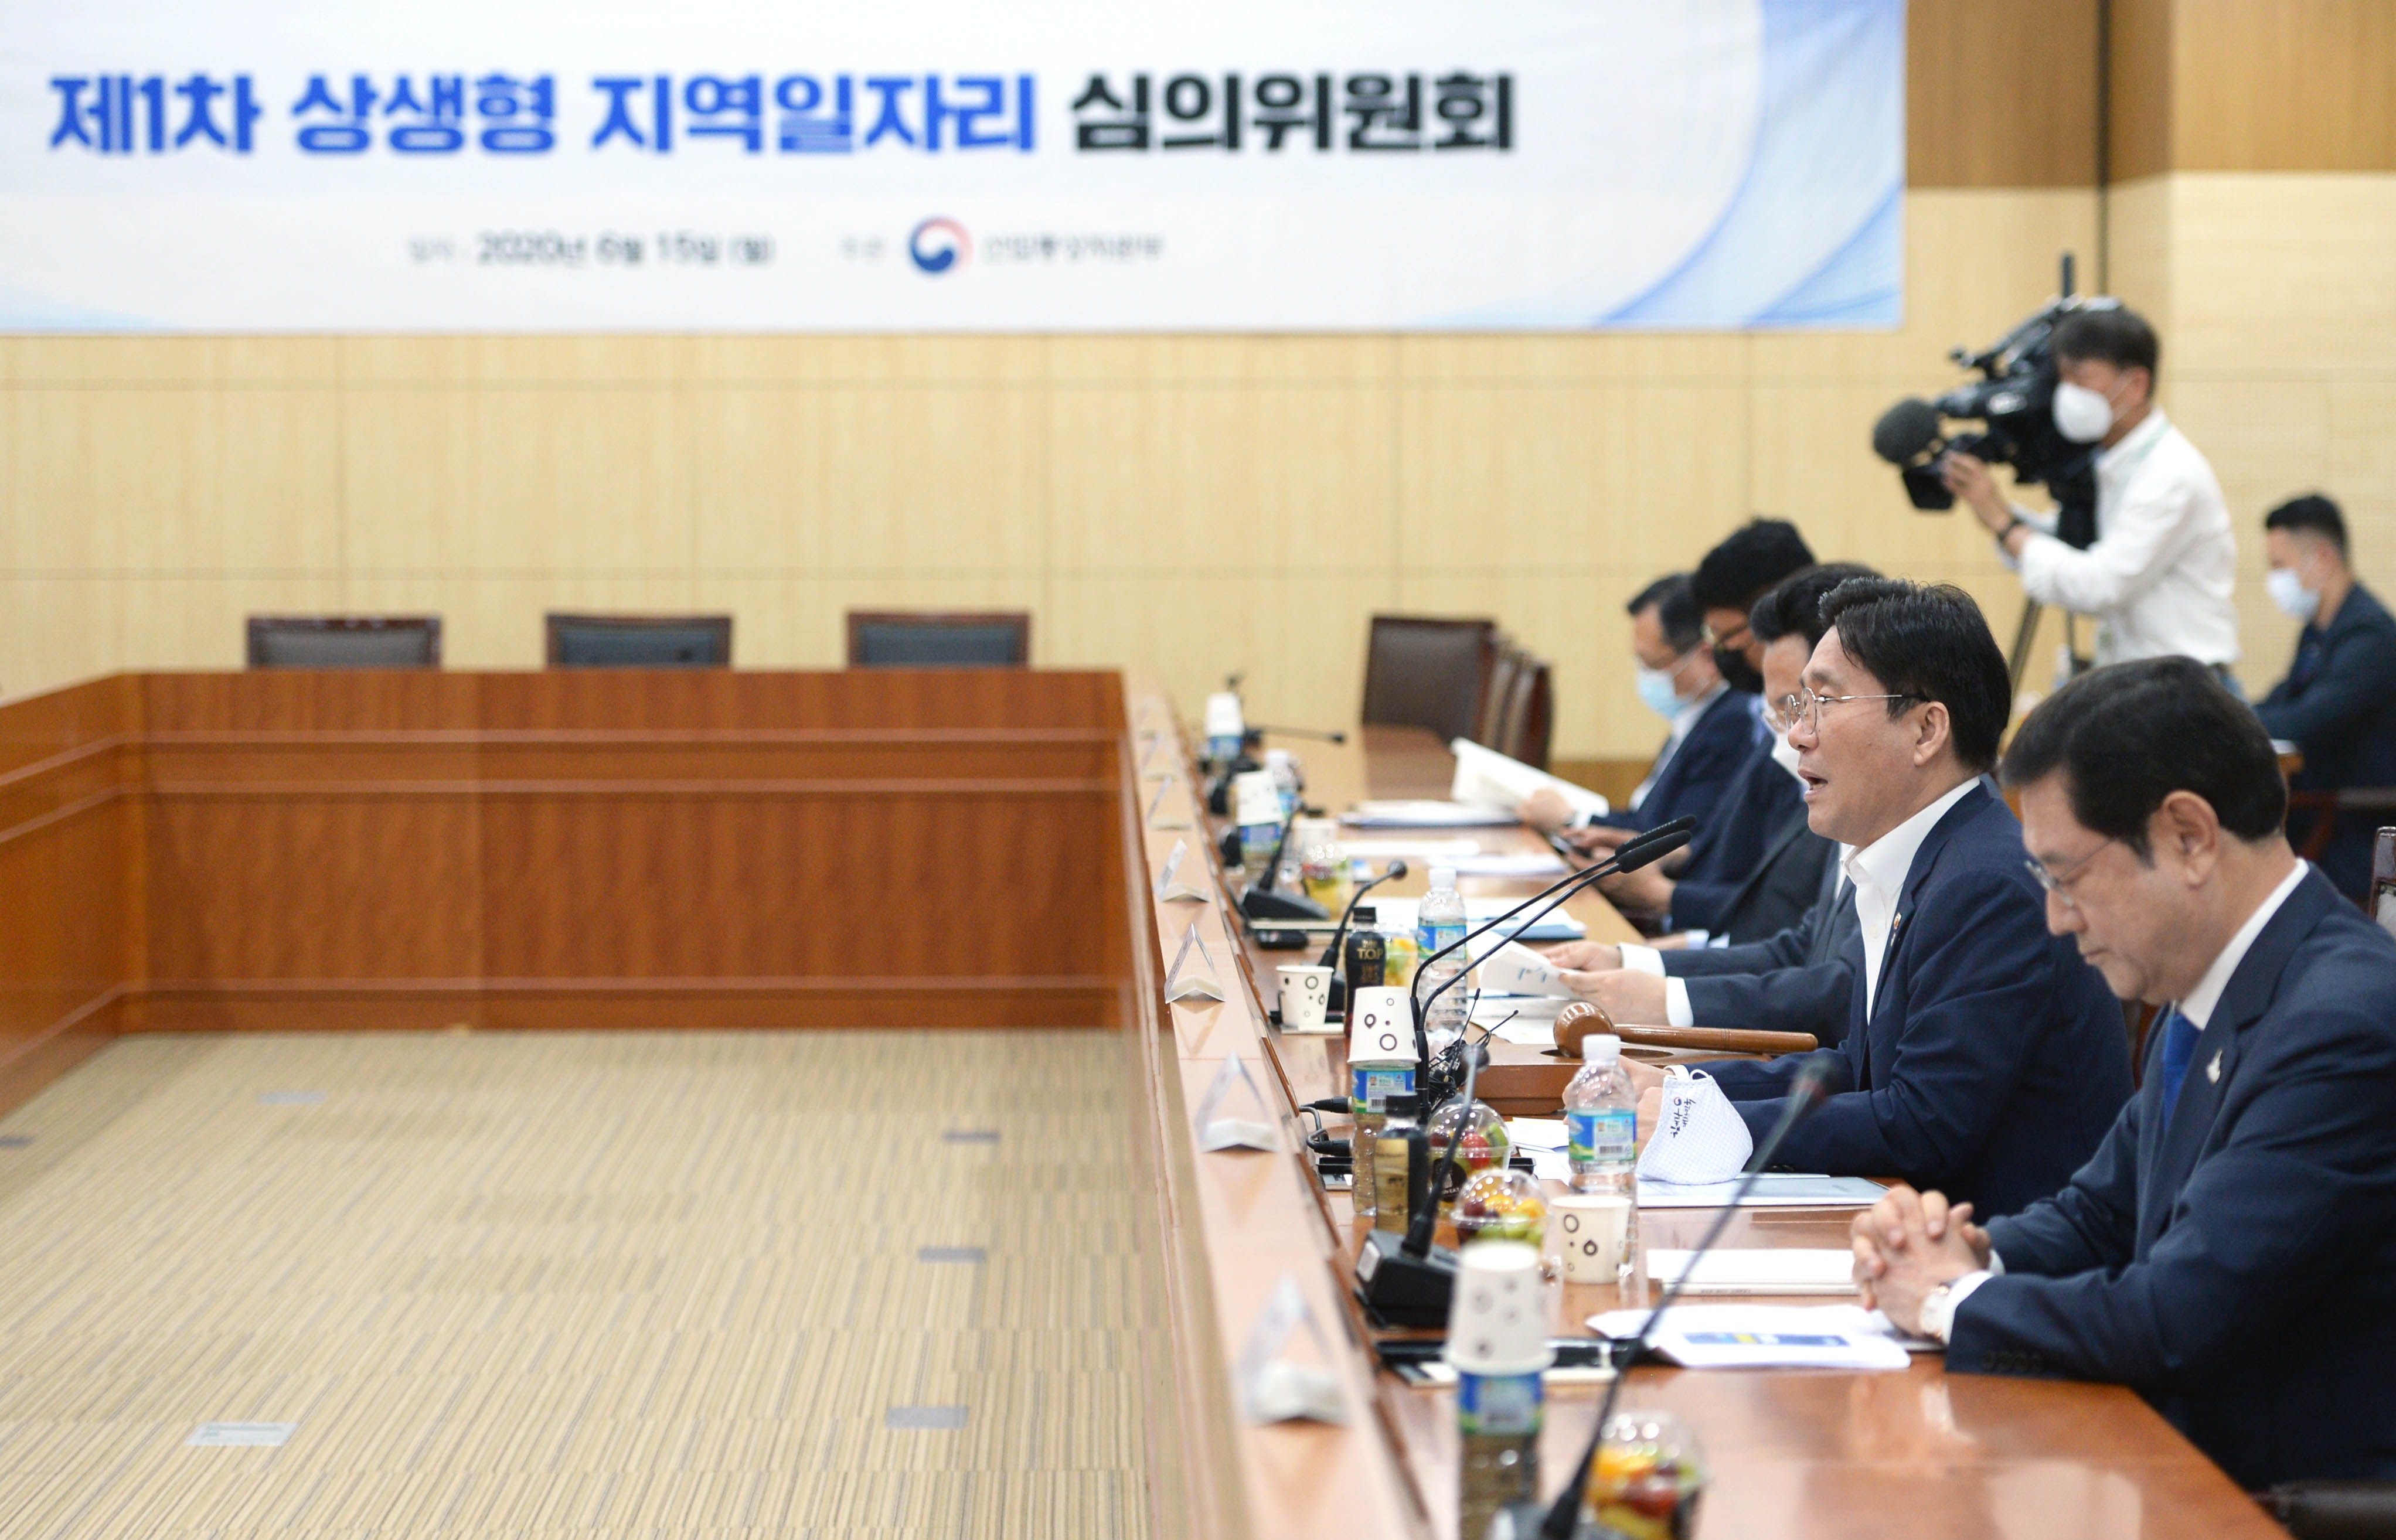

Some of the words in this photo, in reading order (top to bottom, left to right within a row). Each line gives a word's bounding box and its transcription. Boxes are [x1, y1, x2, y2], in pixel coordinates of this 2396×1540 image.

[48, 71, 263, 156] 제1차
[290, 71, 557, 156] 상생형
[590, 71, 1037, 156] 지역일자리
[1069, 69, 1517, 155] 심의위원회
